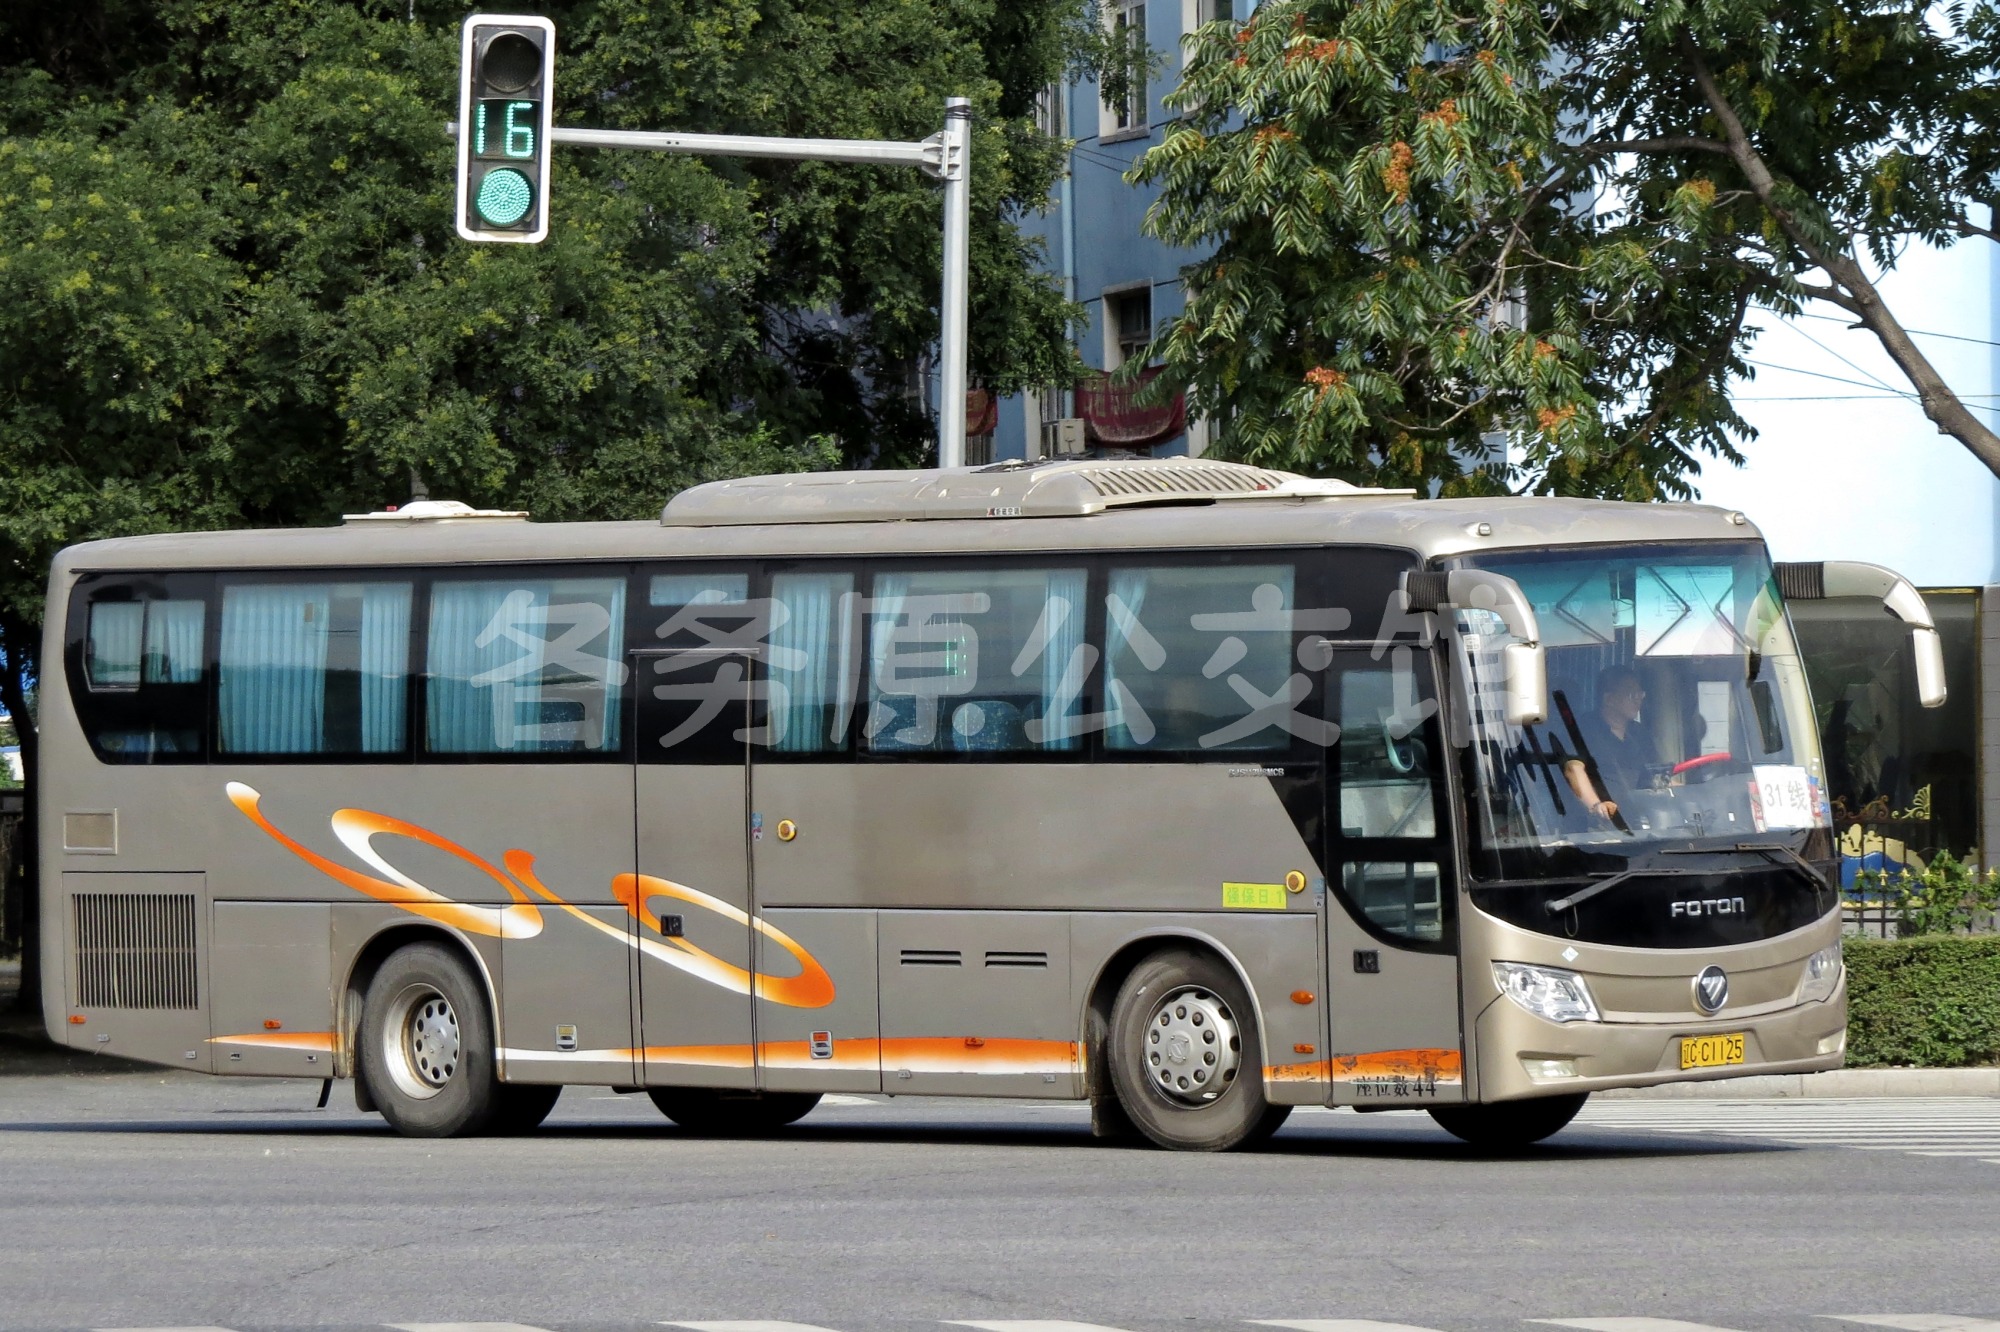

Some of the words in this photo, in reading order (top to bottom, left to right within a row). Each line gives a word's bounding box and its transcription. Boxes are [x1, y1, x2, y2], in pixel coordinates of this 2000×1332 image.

[477, 103, 533, 157] 16
[1671, 896, 1745, 918] FOTON
[1354, 1074, 1437, 1097] 座位数44
